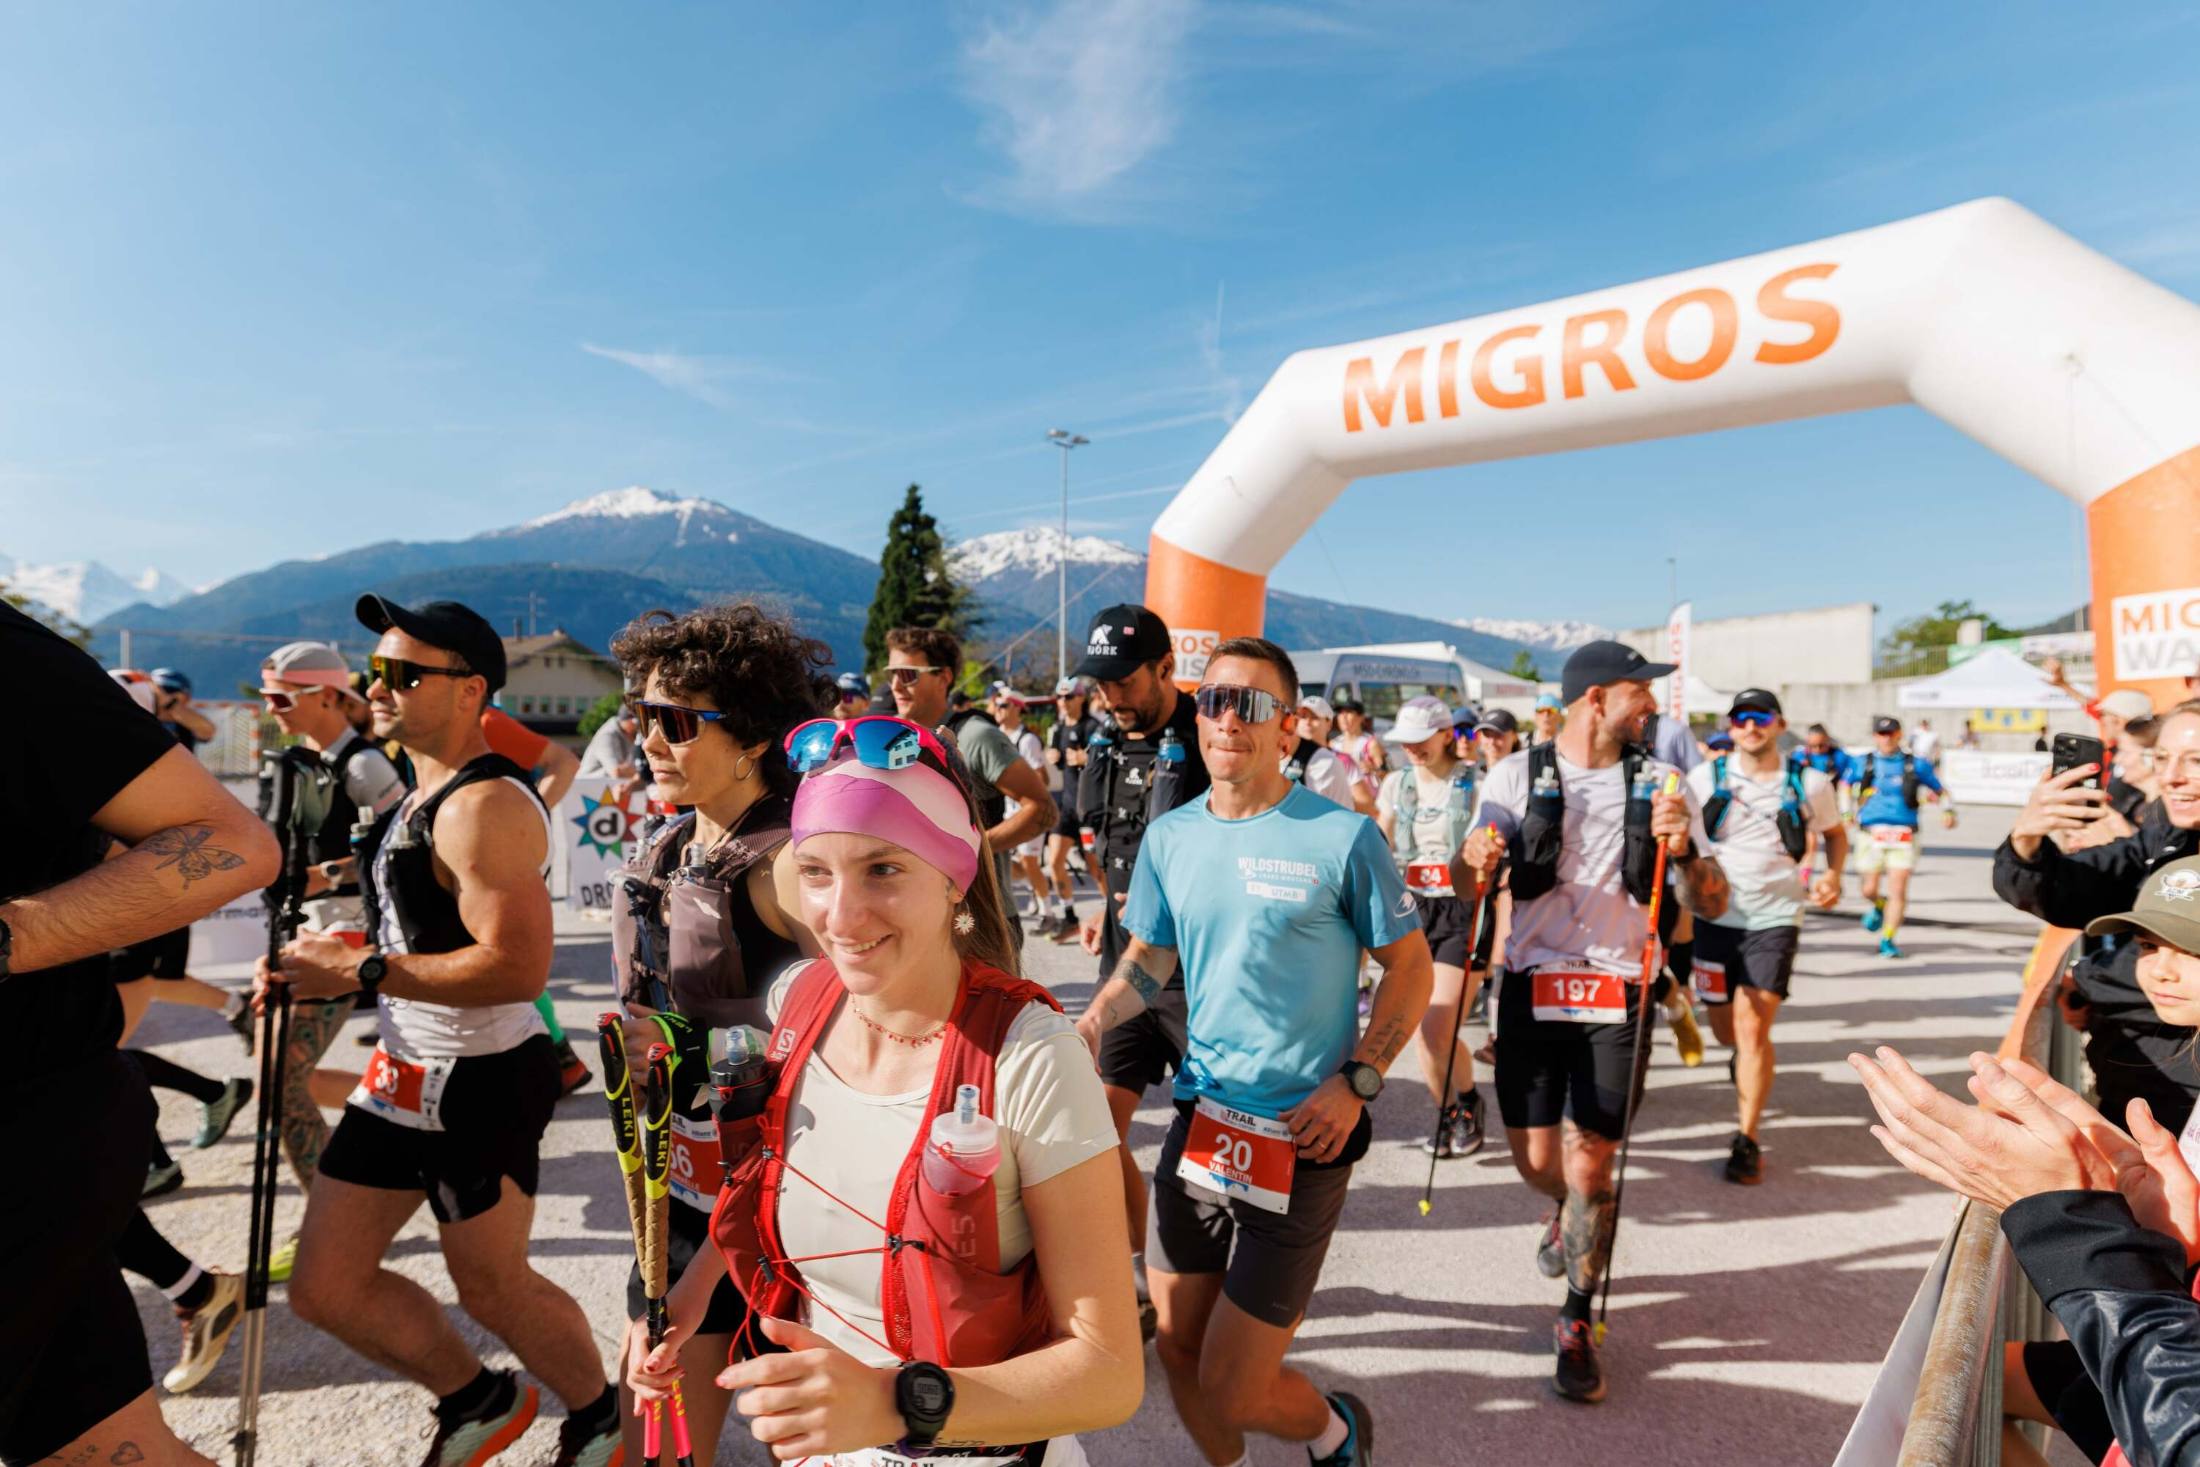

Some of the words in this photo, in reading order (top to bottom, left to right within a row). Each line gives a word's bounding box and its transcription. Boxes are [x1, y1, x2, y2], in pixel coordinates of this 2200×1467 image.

[1344, 263, 1841, 433] MIGROS
[1238, 856, 1317, 876] WILDSTRUBEL
[1554, 979, 1601, 1002] 197
[622, 1097, 634, 1137] LEKI
[1226, 1109, 1256, 1126] TRAIL
[656, 1129, 669, 1167] LEKI
[1212, 1133, 1253, 1171] 20
[1208, 1160, 1253, 1184] VALENTIN
